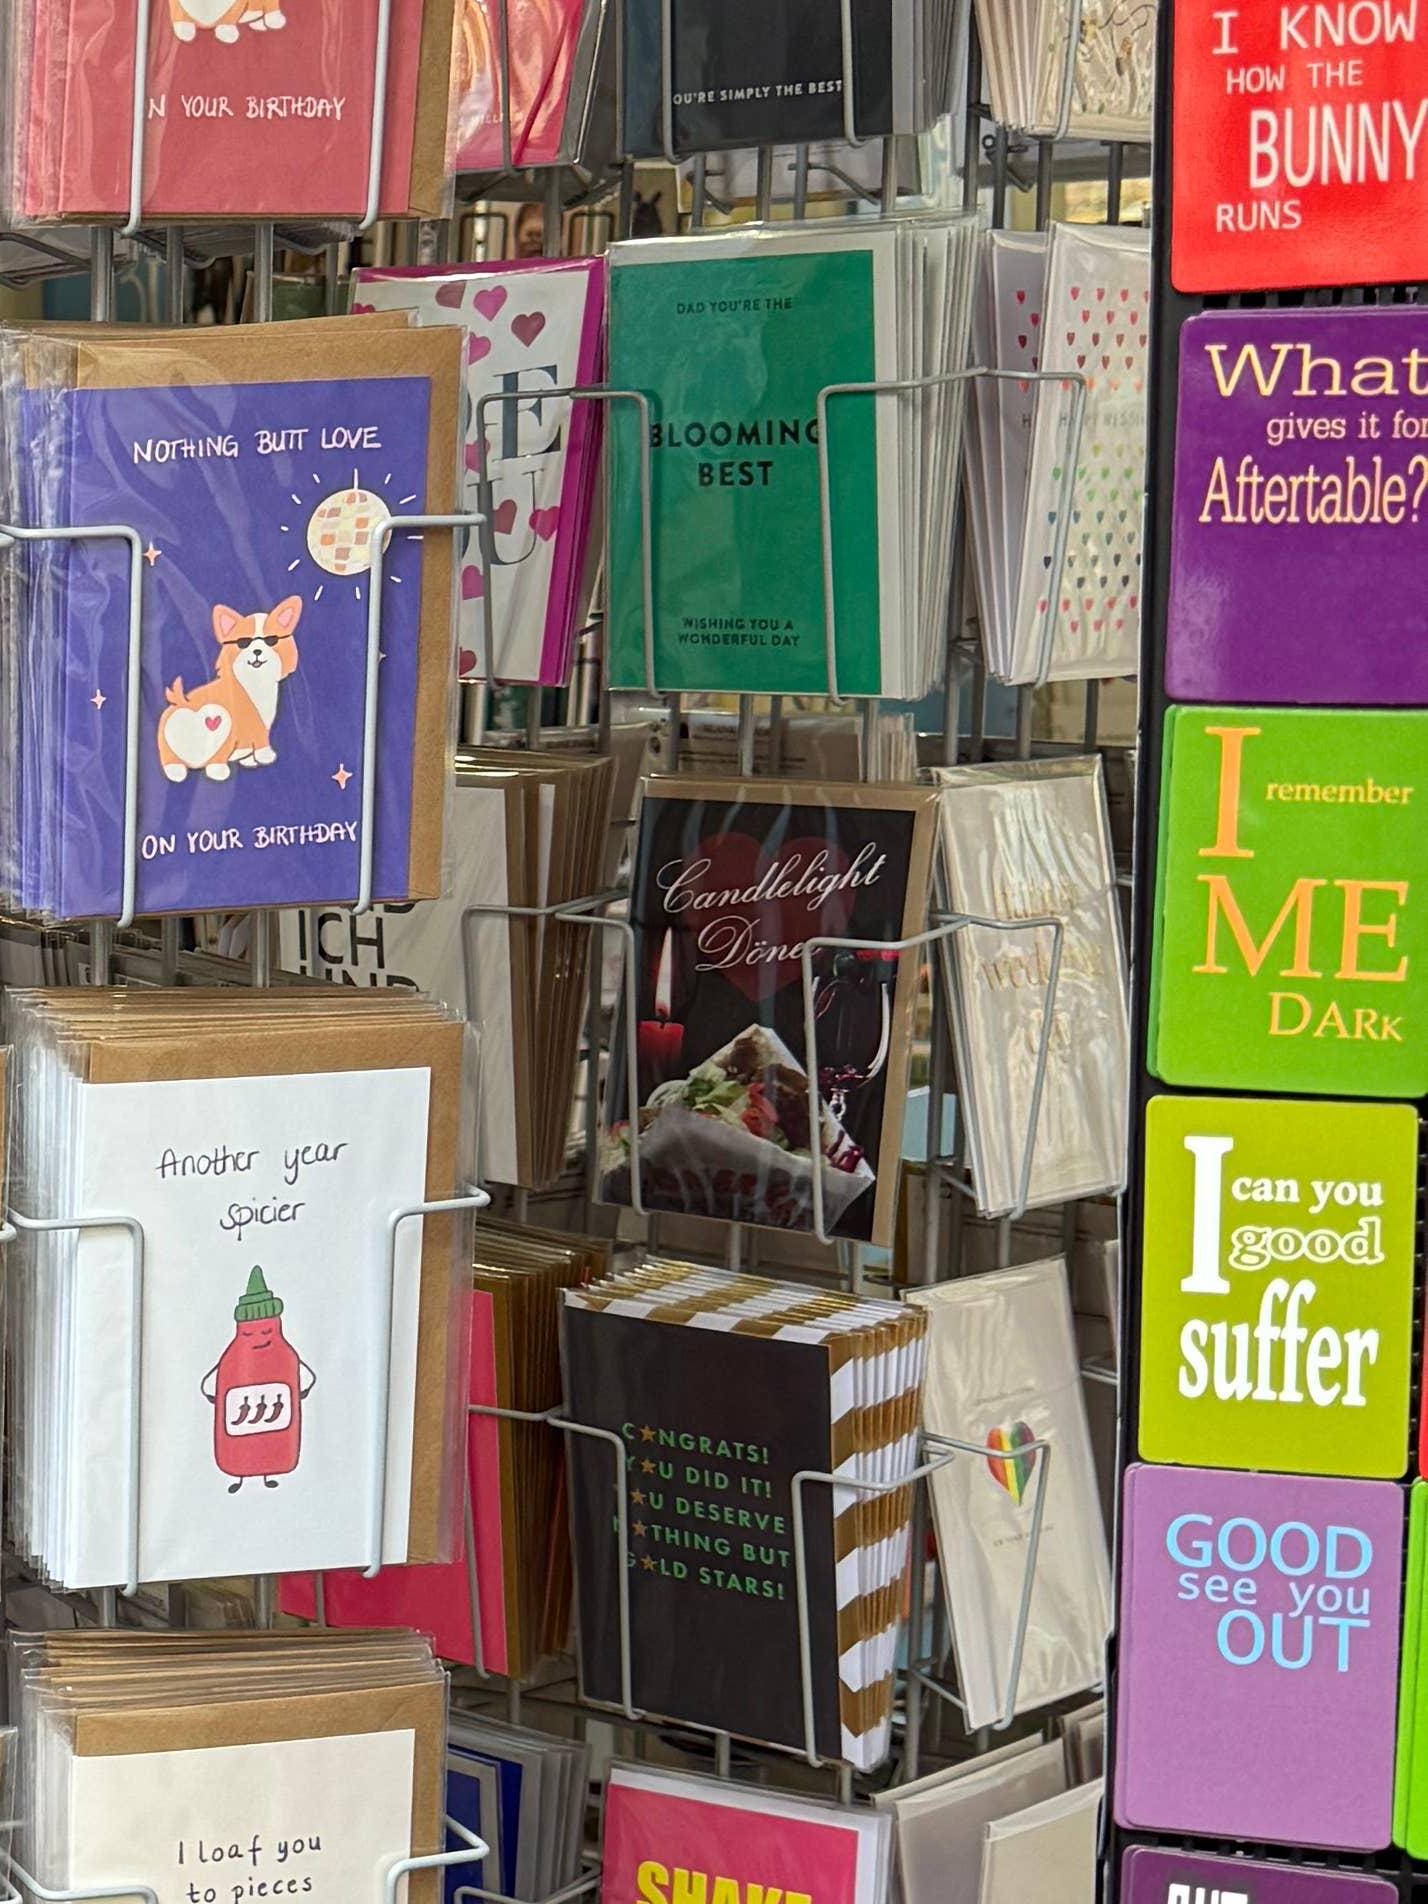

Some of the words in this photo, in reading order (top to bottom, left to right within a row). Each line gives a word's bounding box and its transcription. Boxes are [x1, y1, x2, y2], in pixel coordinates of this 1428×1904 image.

[1212, 11, 1238, 54] I
[1226, 66, 1285, 94] HOW
[1308, 60, 1363, 88] THE
[1249, 100, 1428, 188] BUNNY
[1216, 200, 1302, 232] RUNS
[677, 300, 703, 316] DAD
[707, 299, 756, 315] YOU'RE
[762, 297, 792, 312] THE
[1205, 343, 1428, 396] What
[650, 417, 823, 449] BLOOMING
[1267, 411, 1346, 446] gives
[1358, 411, 1380, 439] it
[1393, 410, 1428, 438] for
[698, 460, 774, 488] BEST
[1199, 454, 1427, 524] Aftertable?
[1199, 727, 1261, 858] I
[1266, 777, 1414, 805] remember
[656, 841, 886, 915] Candlelight
[298, 909, 385, 969] ICH
[1192, 875, 1409, 982] ME
[156, 1146, 259, 1179] Another
[284, 1138, 348, 1178] year
[220, 1199, 305, 1238] spicier
[1181, 1136, 1234, 1294] I
[1232, 1176, 1299, 1203] can
[1309, 1180, 1384, 1214] you
[1228, 1216, 1385, 1271] good
[1179, 1278, 1380, 1407] suffer
[676, 1497, 785, 1534] DESERVE
[1166, 1514, 1373, 1579] GOOD
[699, 1567, 784, 1600] STARS!
[1178, 1572, 1257, 1605] see
[1288, 1582, 1369, 1617] you
[1217, 1610, 1370, 1672] OUT
[196, 1835, 263, 1864] loaf
[275, 1837, 322, 1877] you
[186, 1880, 219, 1904] to
